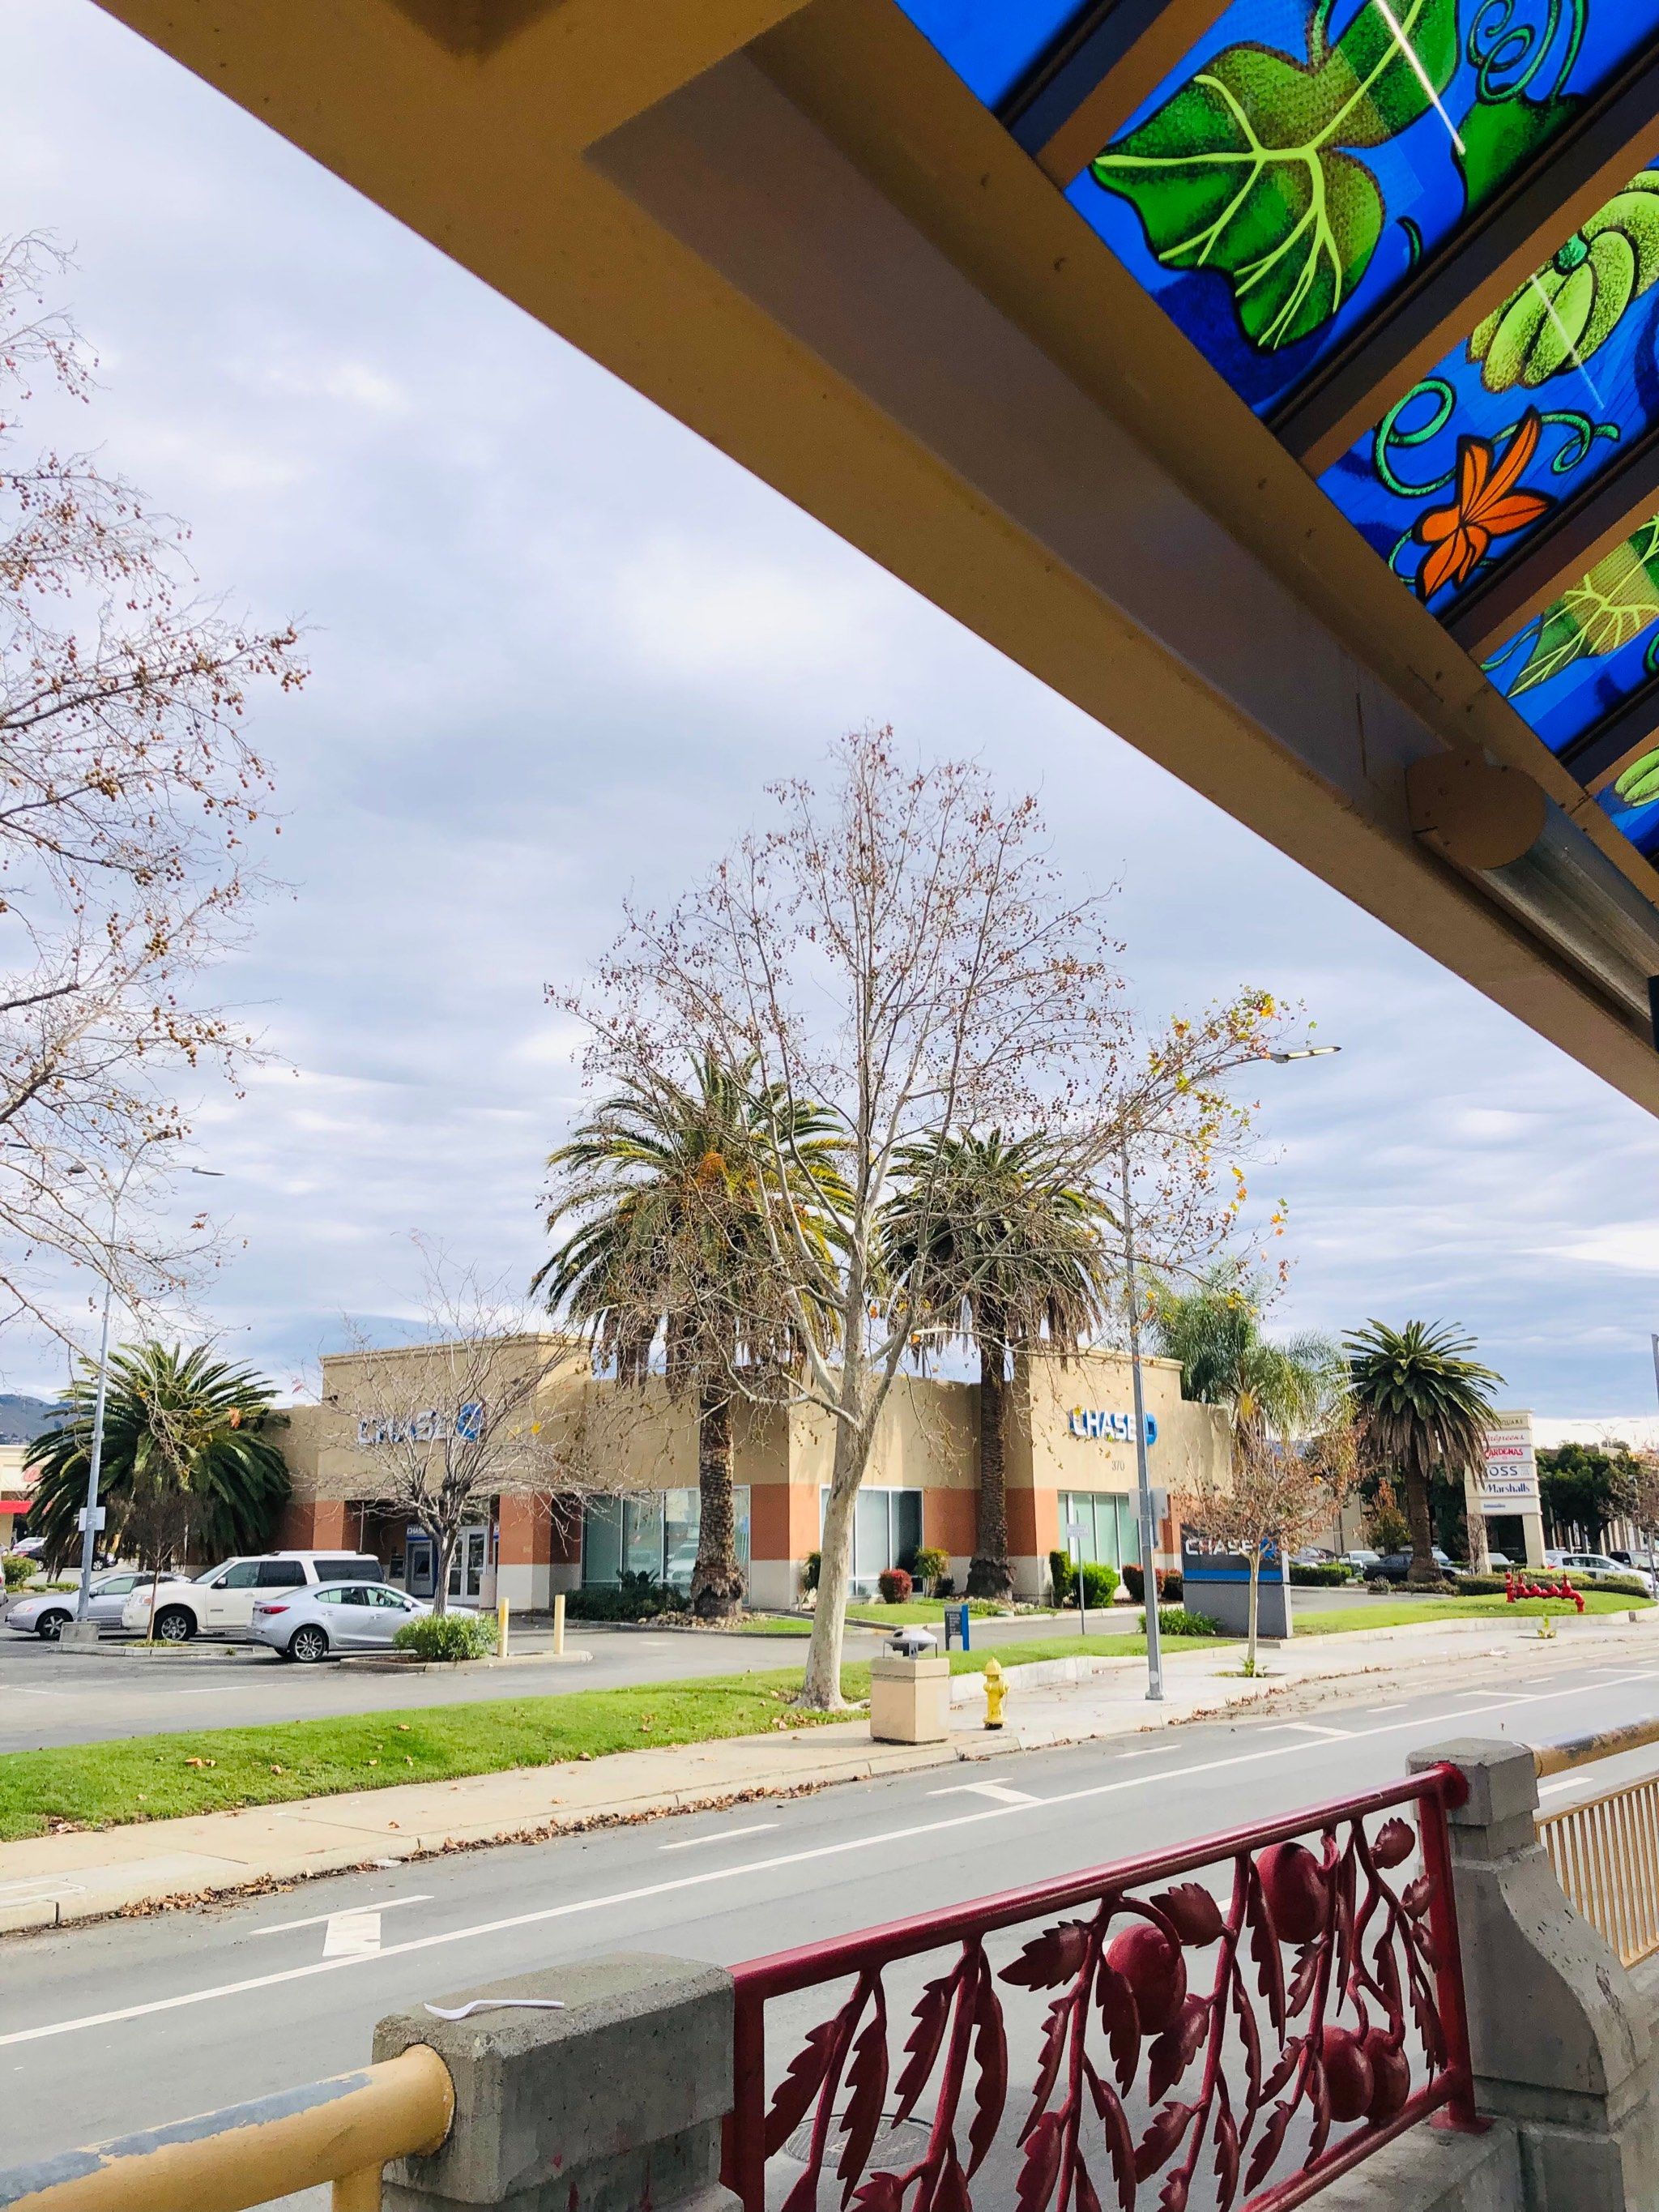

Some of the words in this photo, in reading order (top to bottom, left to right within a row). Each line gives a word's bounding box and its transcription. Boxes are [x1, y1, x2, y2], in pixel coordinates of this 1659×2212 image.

[1069, 1408, 1137, 1441] CHASE
[1485, 1447, 1523, 1459] CARDENAS
[1111, 1460, 1125, 1471] 370
[1487, 1466, 1518, 1476] OSS
[1485, 1482, 1530, 1493] Marshalls
[1185, 1538, 1254, 1555] CHASE
